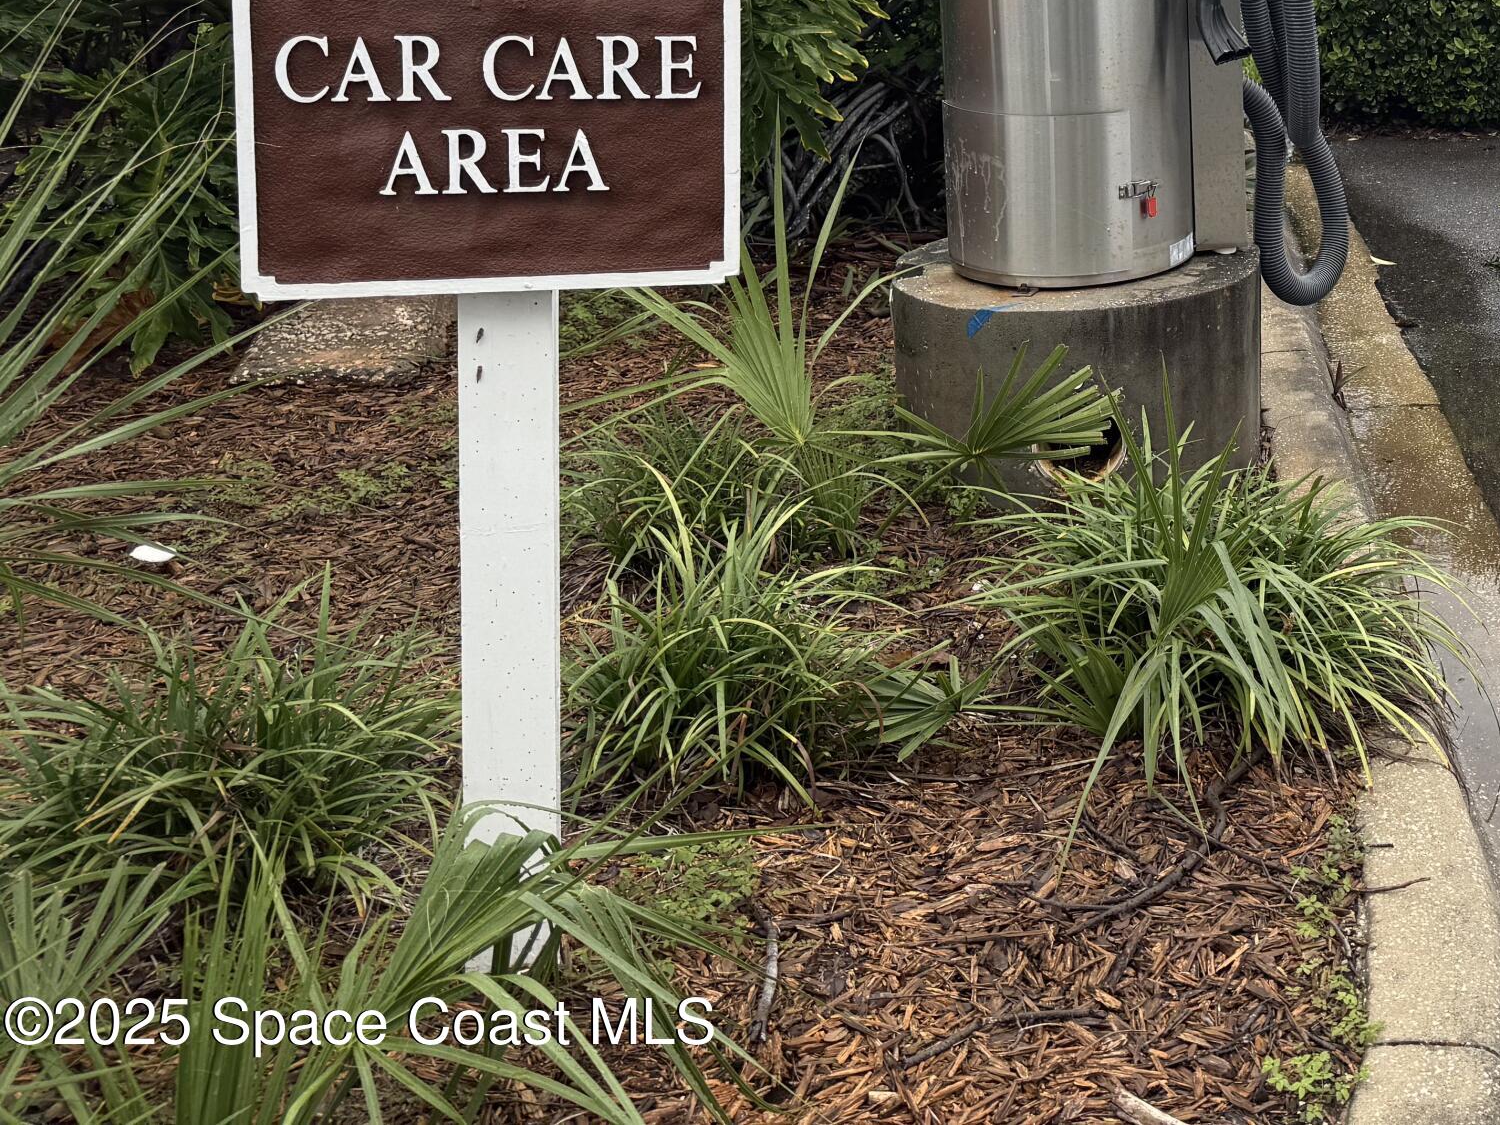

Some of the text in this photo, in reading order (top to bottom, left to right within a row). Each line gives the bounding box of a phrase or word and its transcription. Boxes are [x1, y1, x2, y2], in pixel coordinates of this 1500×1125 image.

[274, 35, 702, 104] CAR CARE
[379, 128, 610, 196] AREA
